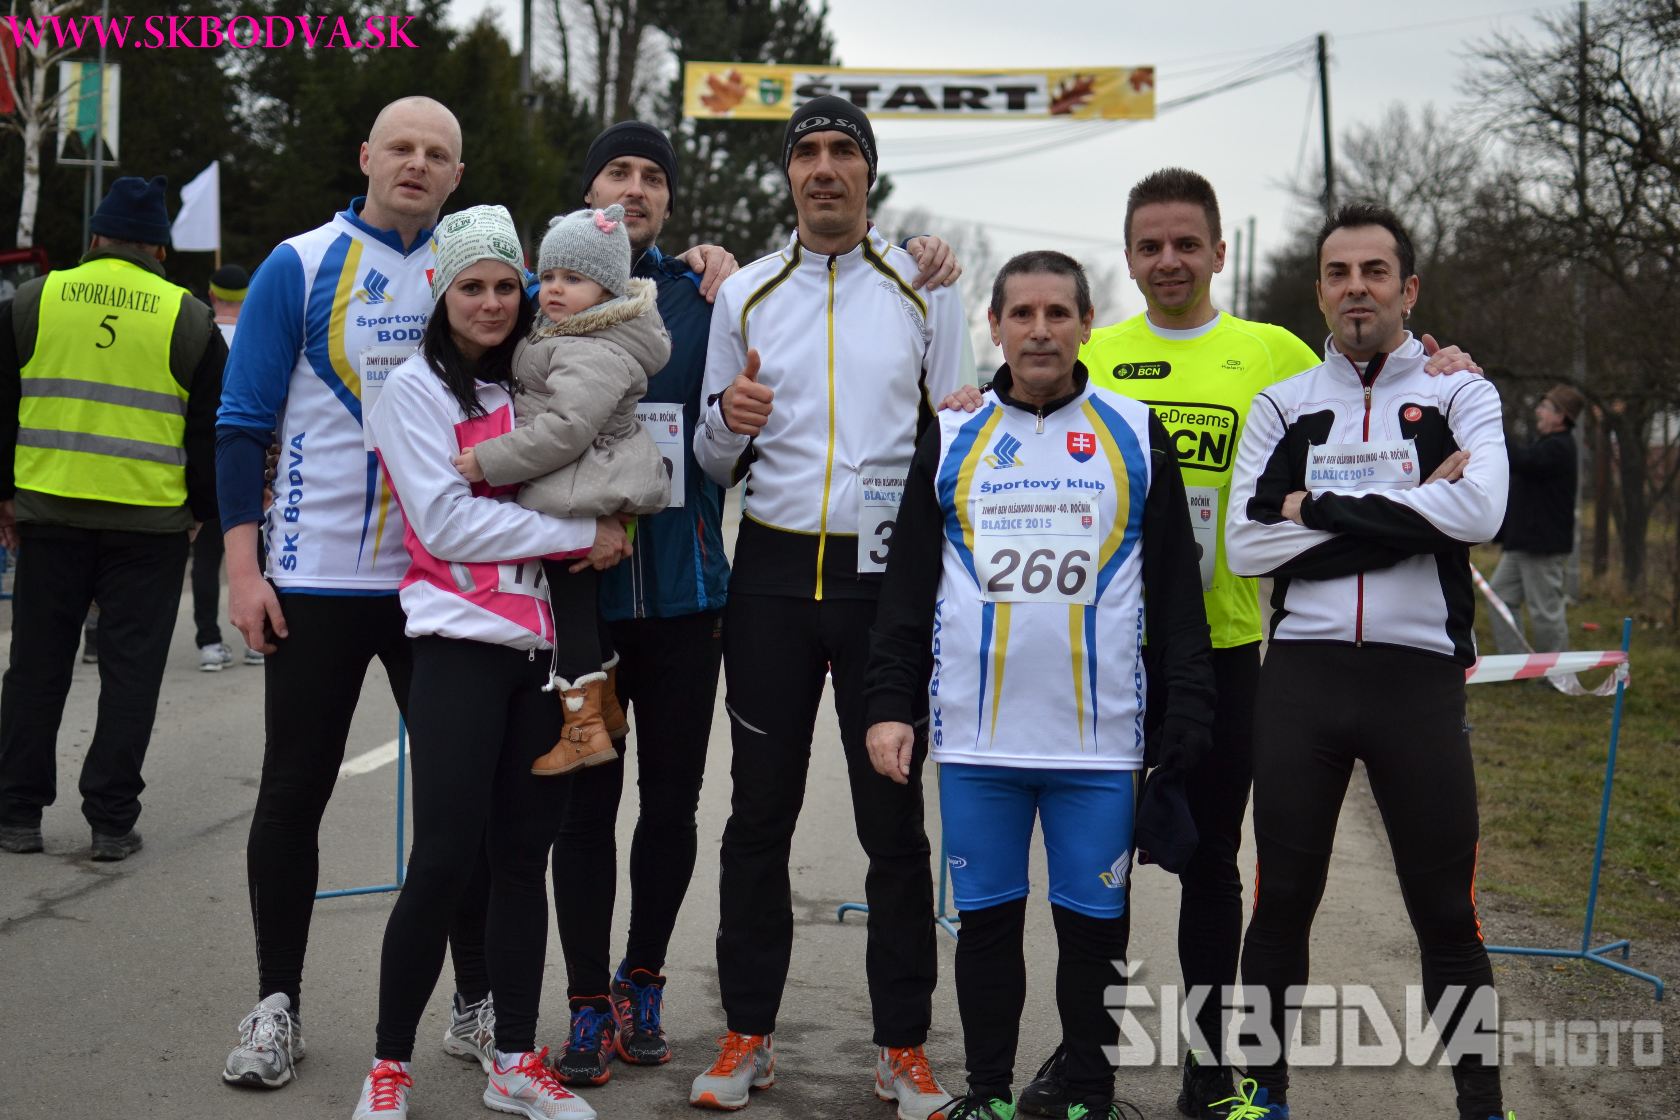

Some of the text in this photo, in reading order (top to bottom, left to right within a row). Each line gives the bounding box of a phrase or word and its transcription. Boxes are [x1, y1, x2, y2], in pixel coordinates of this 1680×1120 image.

[795, 75, 1038, 112] ŠTART
[356, 313, 428, 328] Športový
[95, 314, 119, 349] 5
[1137, 367, 1161, 376] BCN
[1159, 409, 1230, 429] eDreams
[1169, 429, 1228, 465] CN
[1311, 467, 1375, 481] BLAŽICE 2015
[980, 478, 1106, 493] Športový klub
[278, 431, 306, 572] ŠK BODVA
[1070, 501, 1091, 514] ROČNÍK
[1190, 495, 1210, 507] ROČNÍK
[981, 518, 1053, 530] BLAŽICE 2015
[988, 548, 1091, 596] 266
